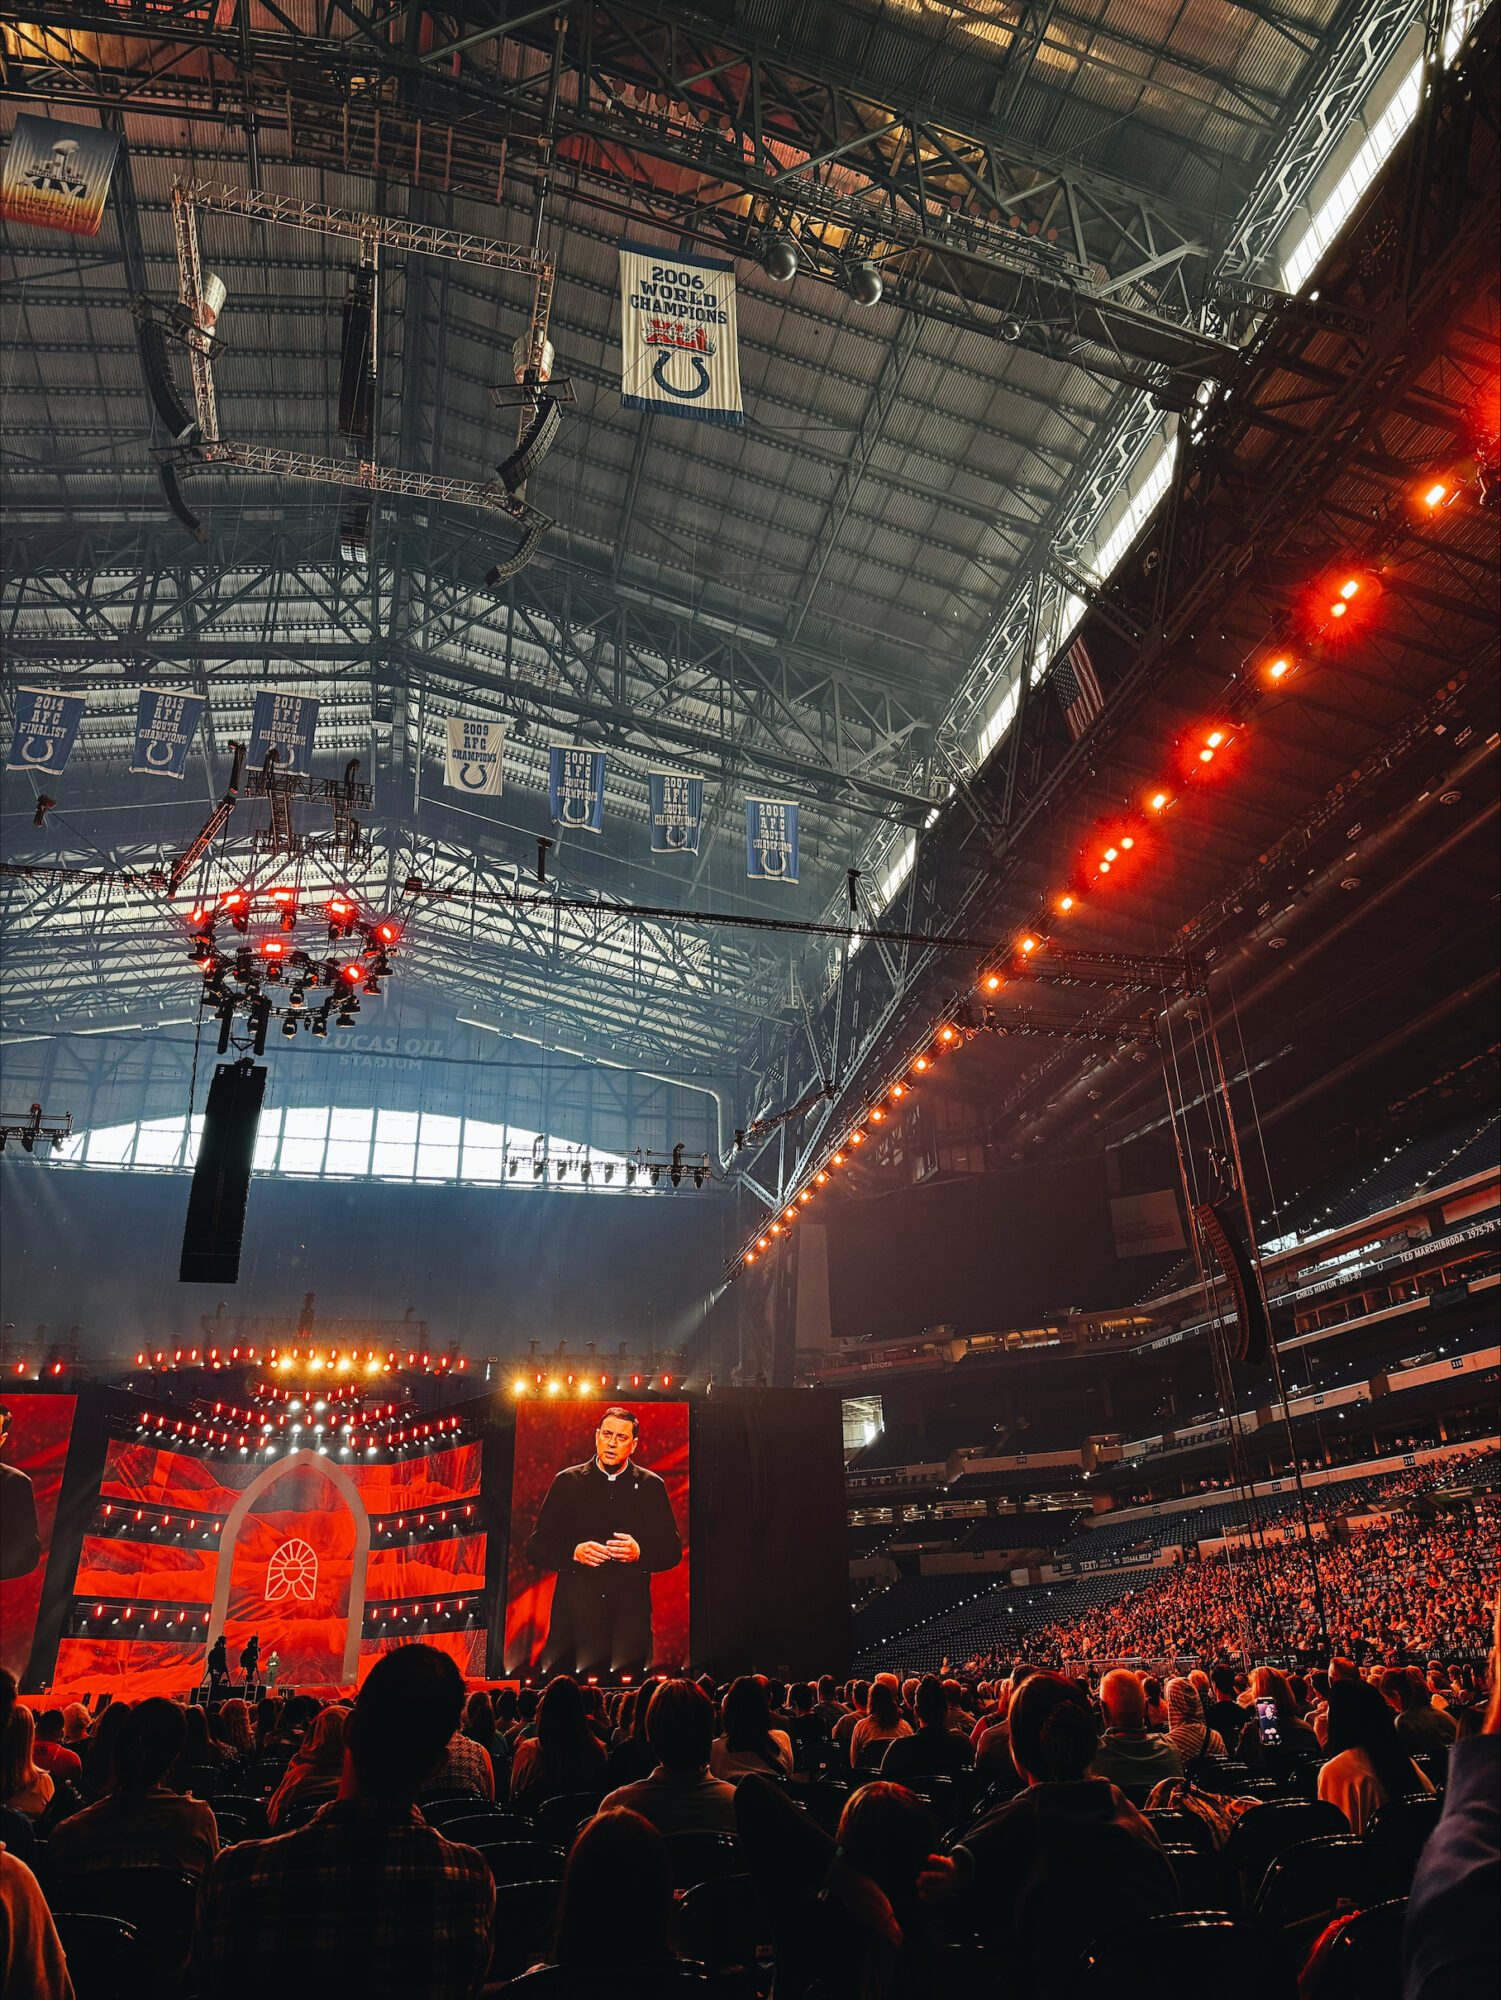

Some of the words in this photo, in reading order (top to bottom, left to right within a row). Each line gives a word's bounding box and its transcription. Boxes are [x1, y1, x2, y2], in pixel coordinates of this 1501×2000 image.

[25, 196, 54, 206] HOST
[652, 266, 705, 289] 2006
[640, 280, 717, 308] WORLD
[630, 293, 727, 324] CHAMPIONS
[34, 695, 65, 711] 2014
[156, 695, 185, 710] 2013
[273, 695, 302, 710] 2010
[31, 709, 61, 725] AFC
[153, 707, 182, 722] AFC
[273, 707, 300, 723] AFC
[19, 722, 67, 738] FINALIST
[151, 719, 179, 733] SOUTH
[271, 721, 298, 734] SOUTH
[463, 722, 489, 736] 2009
[139, 728, 187, 744] CHAMPIONS
[260, 730, 306, 746] CHAMPIONS
[464, 736, 487, 750] AFC
[452, 749, 497, 763] CHAMPIONS
[565, 751, 592, 765] 2009
[564, 763, 591, 779] AFC
[564, 776, 590, 790] SOUTH
[664, 776, 689, 789] 2007
[557, 786, 598, 801] CHAMPIONS
[664, 787, 688, 803] AFC
[663, 803, 688, 815] SOUTH
[760, 817, 785, 831] AFC
[760, 829, 785, 841] SOUTH
[752, 838, 793, 853] CHAMPIONS
[318, 1033, 399, 1052] LUCAS
[405, 1038, 445, 1056] OIL
[339, 1053, 422, 1070] STADIUM
[1399, 1252, 1414, 1263] TED
[1414, 1234, 1465, 1258] MARCHIBRODA
[1467, 1222, 1495, 1240] 1975-79
[1295, 1286, 1314, 1300] CHRIS
[1314, 1279, 1337, 1294] HINTON
[868, 1361, 893, 1370] TOYOTA
[1452, 1359, 1463, 1369] 310
[1404, 1457, 1415, 1466] 210
